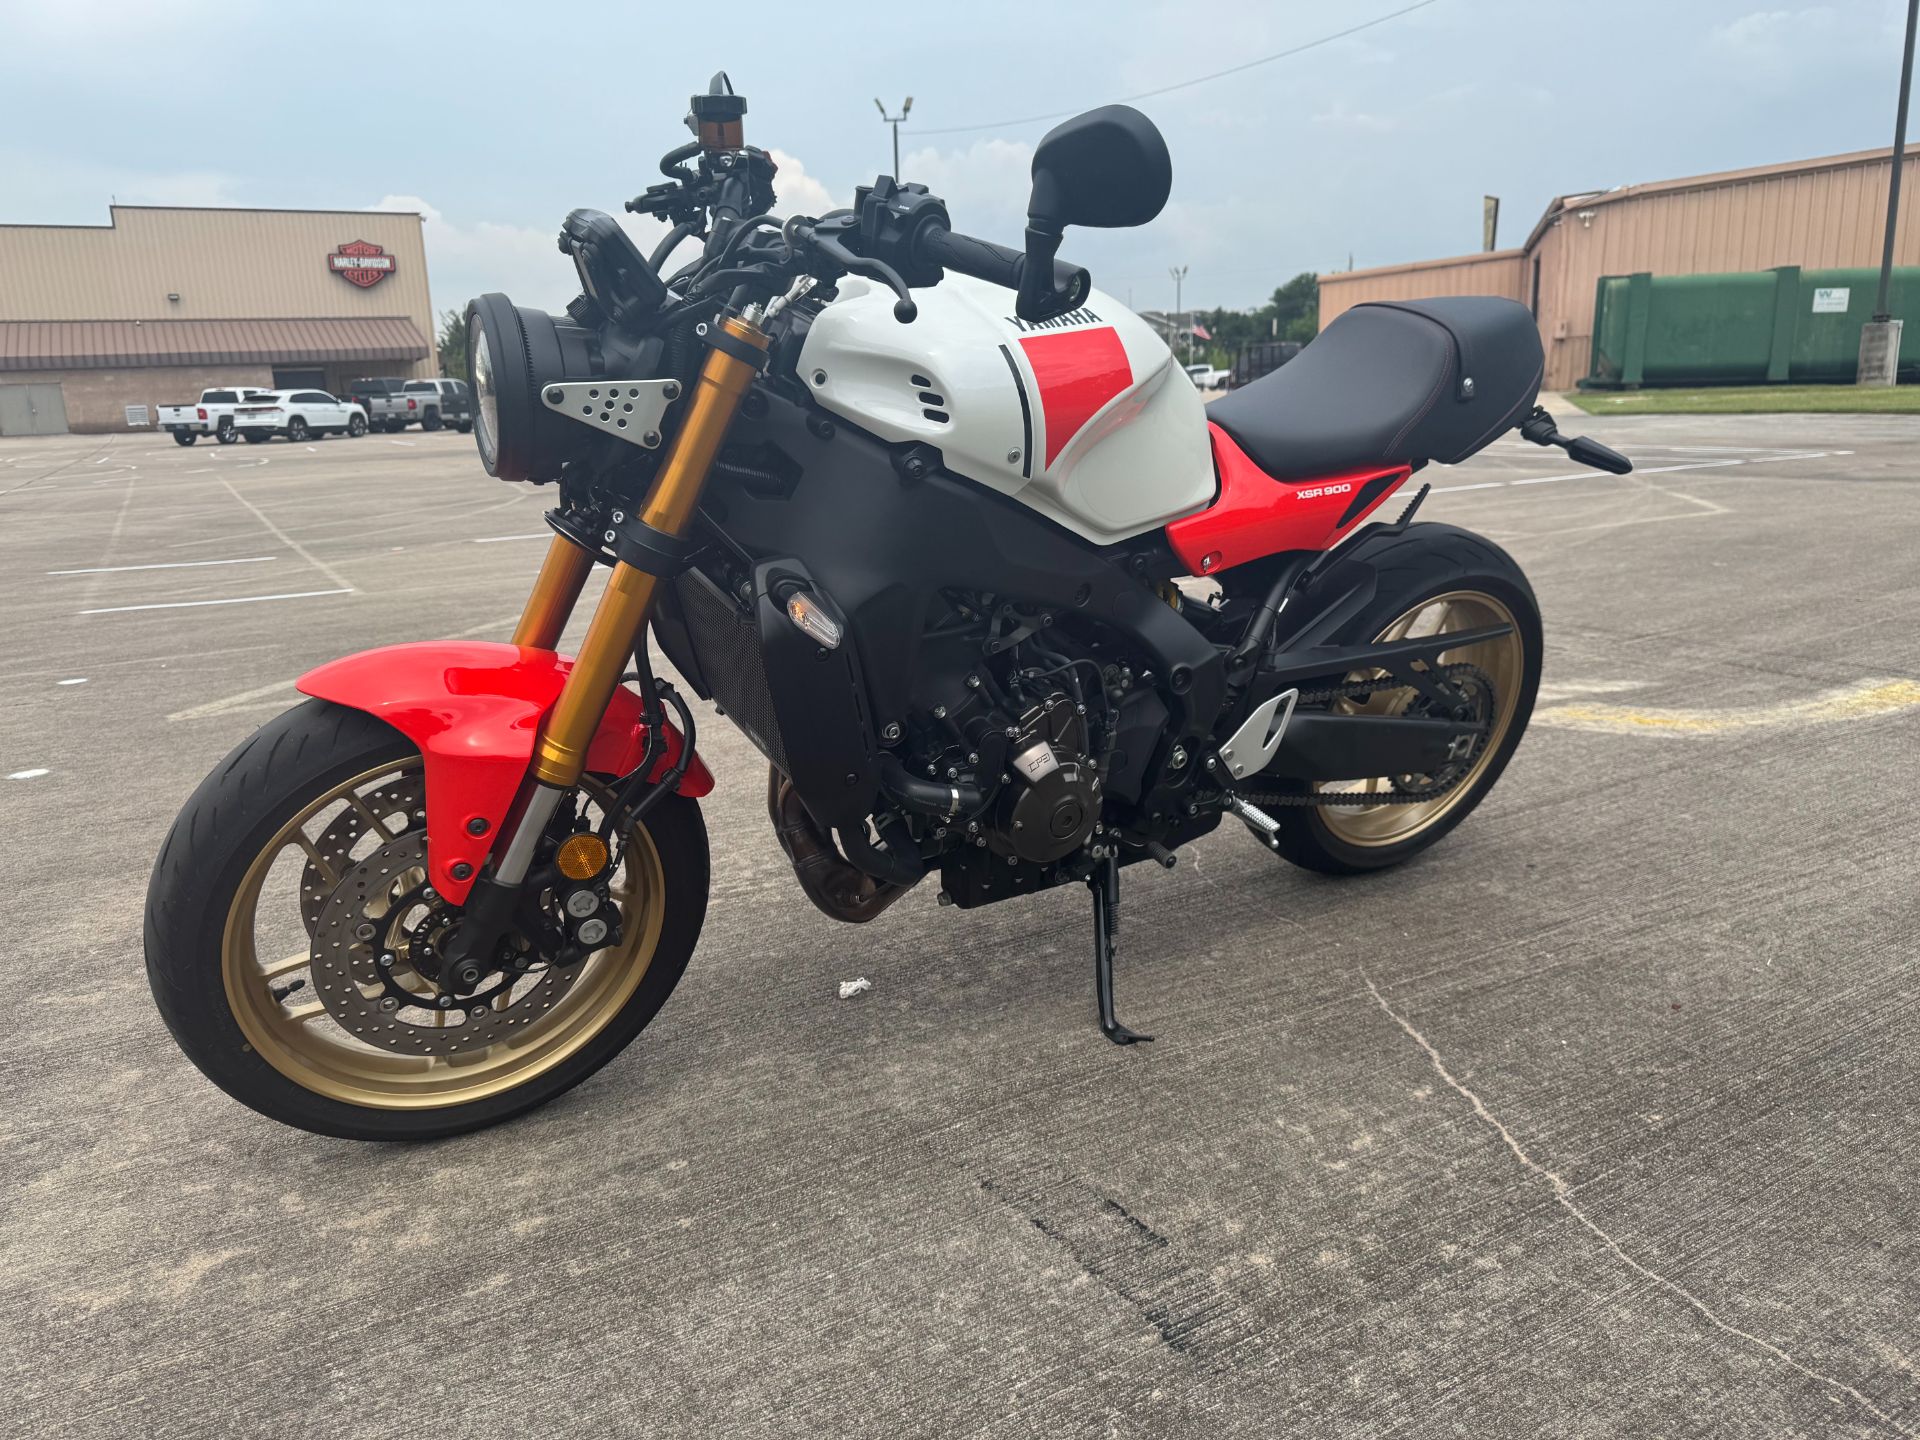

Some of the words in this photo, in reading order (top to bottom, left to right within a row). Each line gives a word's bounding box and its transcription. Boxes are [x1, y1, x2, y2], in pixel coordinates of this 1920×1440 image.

[345, 245, 377, 254] MOTOR
[333, 256, 391, 269] HARLEY-DAVIDSON
[348, 270, 379, 283] CYCLES
[1004, 307, 1103, 332] YAMAHA
[1296, 488, 1323, 500] XSR
[1324, 483, 1352, 496] 900
